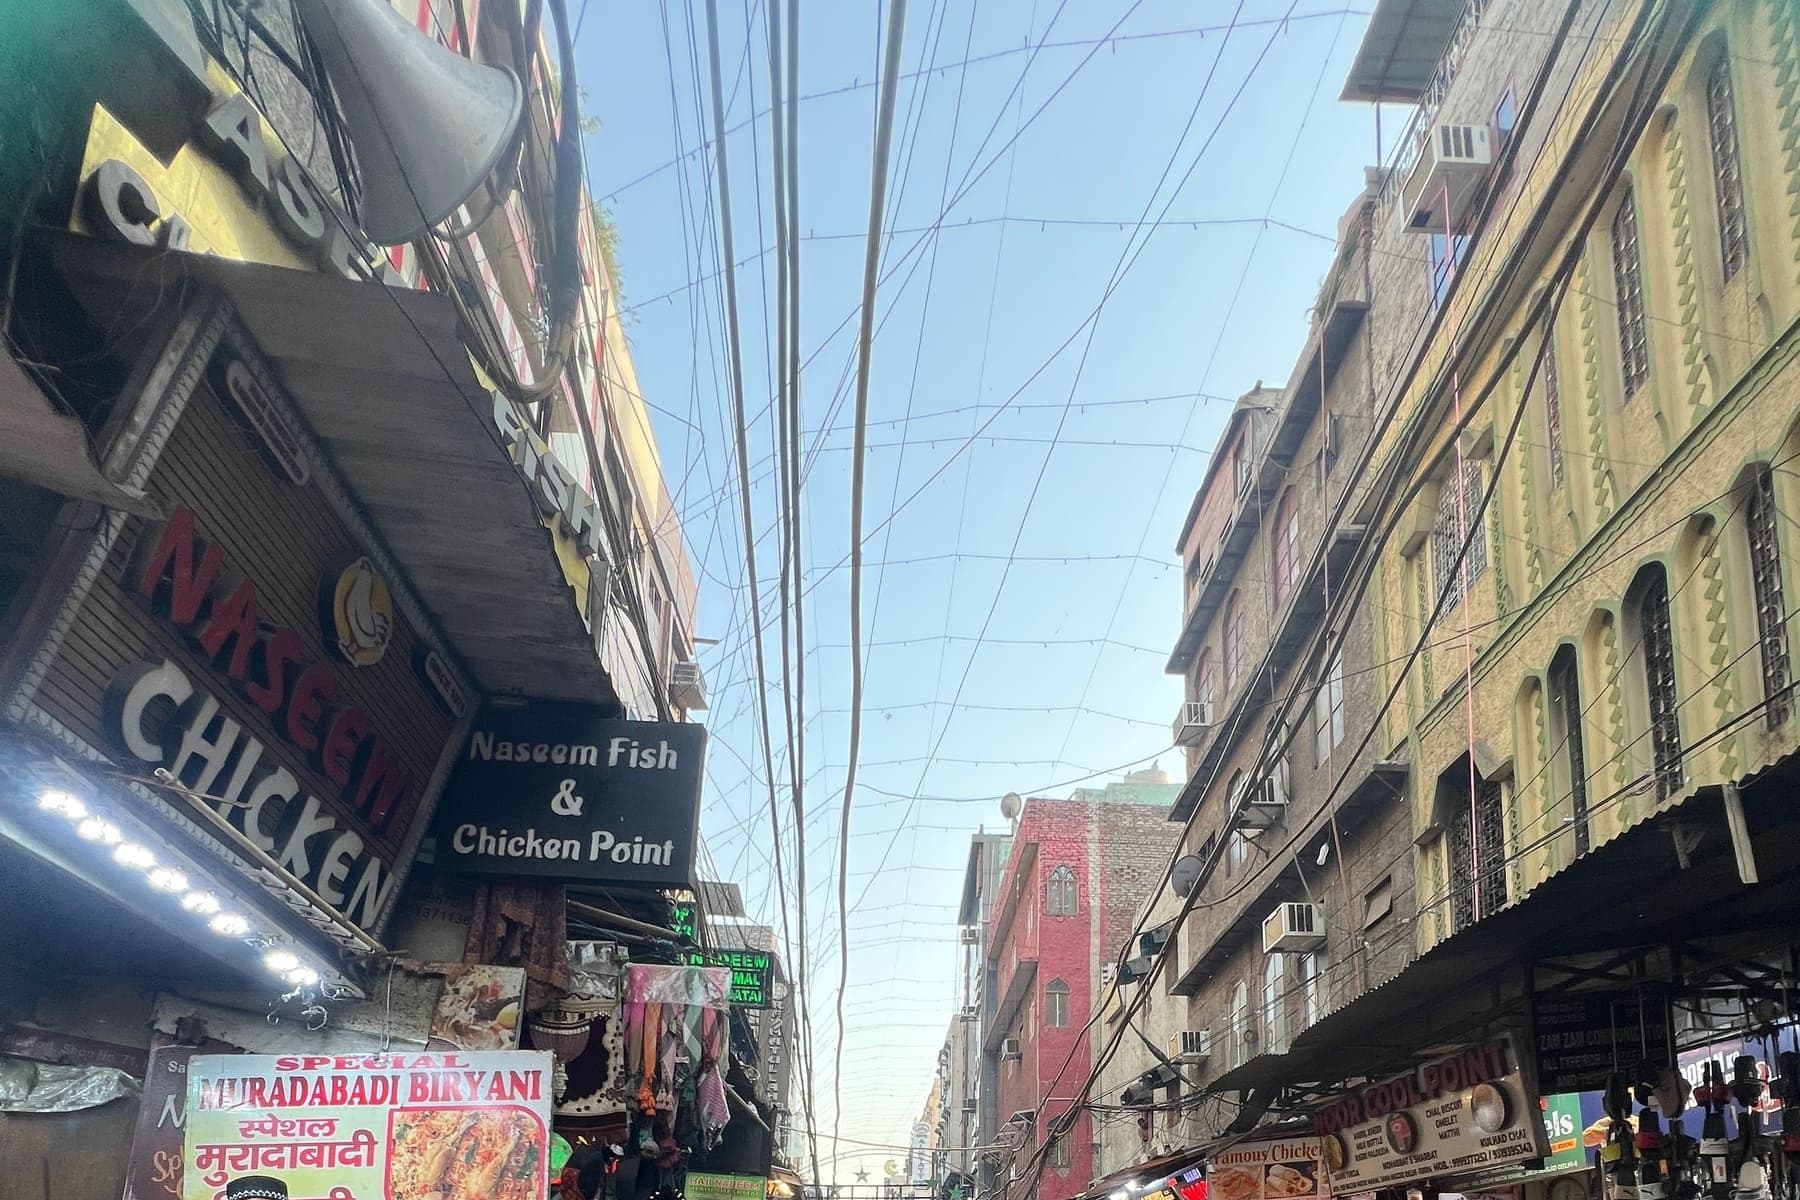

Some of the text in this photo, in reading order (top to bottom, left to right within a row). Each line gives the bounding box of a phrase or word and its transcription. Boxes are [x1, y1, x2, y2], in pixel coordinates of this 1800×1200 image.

[493, 390, 601, 558] FISH
[138, 504, 416, 838] NASEEM
[470, 731, 678, 770] Naseem Fish
[120, 658, 396, 930] CHICKEN
[550, 778, 584, 816] &
[453, 824, 675, 867] Chicken Point
[275, 1054, 471, 1072] SPECIAL
[1364, 1075, 1423, 1119] COOL
[1423, 1040, 1509, 1099] POINT
[198, 1070, 543, 1111] MURADABADI BIRYANI
[238, 1113, 340, 1139] स्पेशल
[195, 1129, 379, 1188] मुरादाबादी
[1211, 1149, 1267, 1166] Famous
